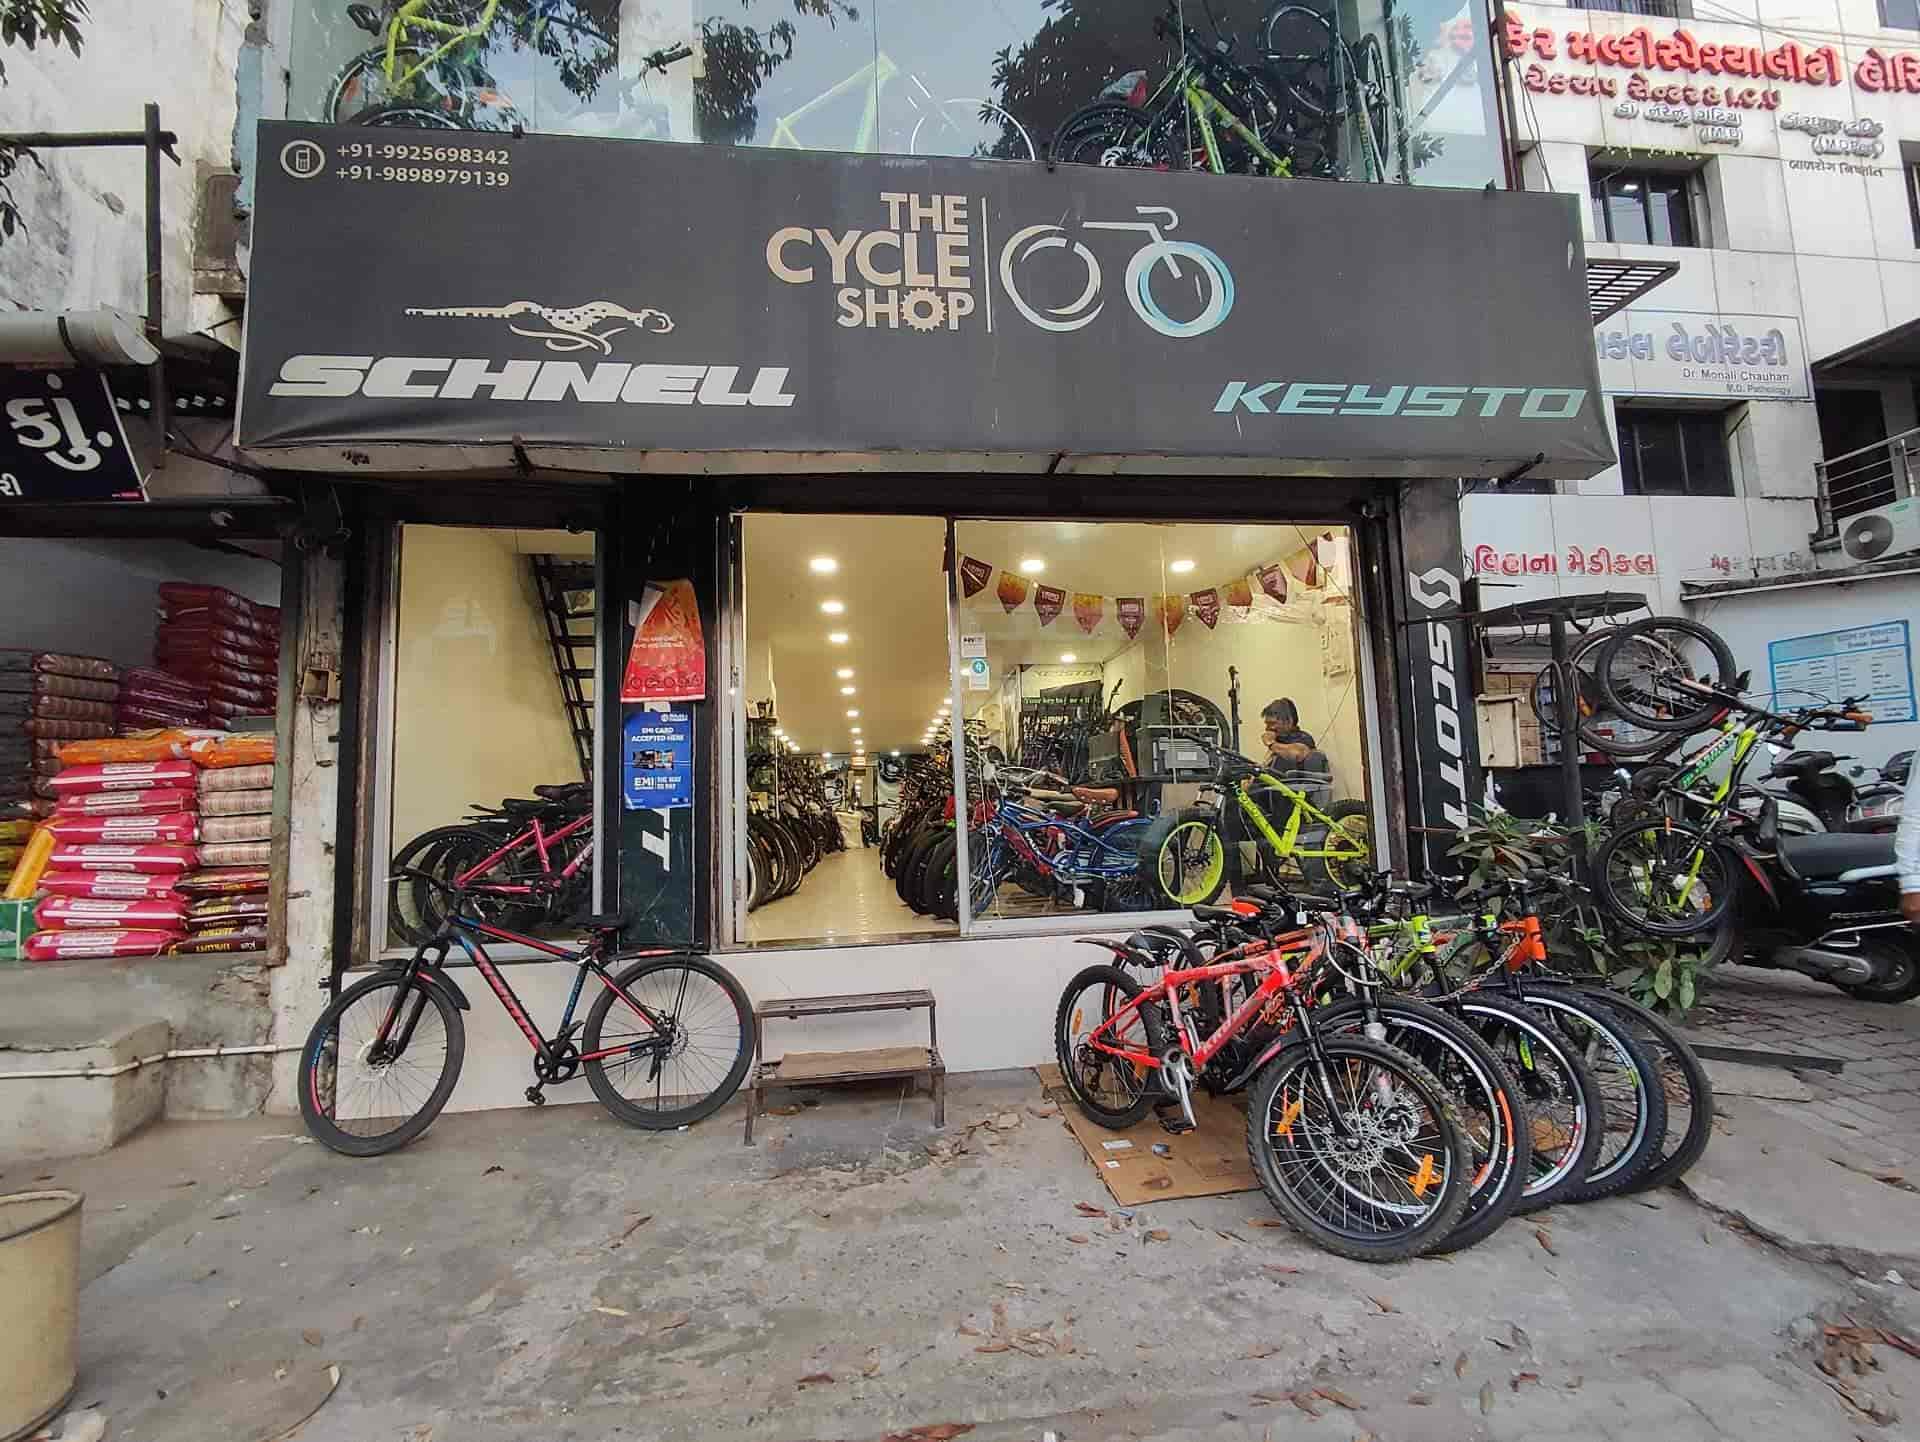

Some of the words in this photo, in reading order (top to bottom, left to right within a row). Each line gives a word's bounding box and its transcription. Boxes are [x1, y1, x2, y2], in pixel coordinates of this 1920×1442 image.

[336, 143, 510, 165] +91-9925698342
[335, 165, 511, 187] +91-9898979139
[880, 191, 969, 233] THE
[766, 226, 971, 289] CYCLE
[836, 286, 976, 334] SHOP
[268, 354, 797, 407] SCHNELL
[1700, 368, 1738, 381] Monali
[1740, 371, 1790, 383] Chauhan
[1213, 380, 1589, 419] KEYSTO
[1426, 615, 1470, 843] SCOTT
